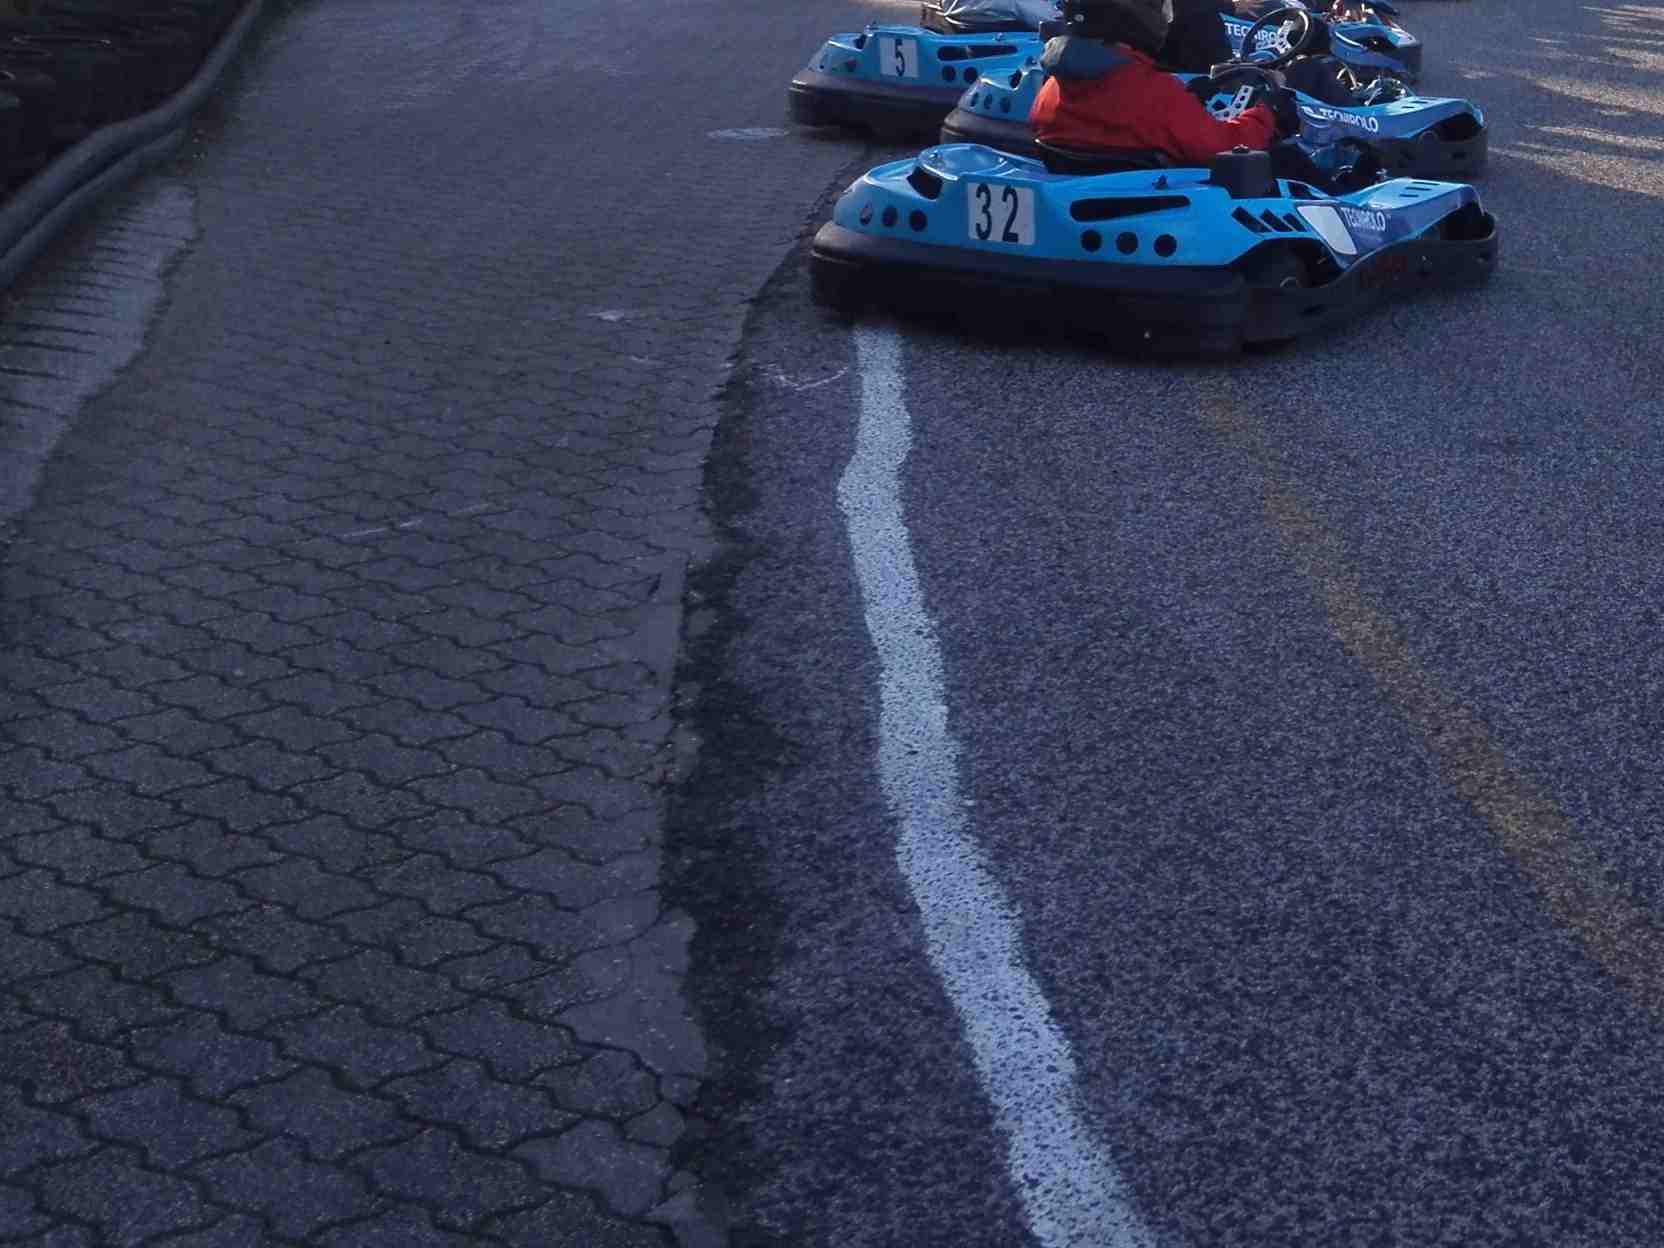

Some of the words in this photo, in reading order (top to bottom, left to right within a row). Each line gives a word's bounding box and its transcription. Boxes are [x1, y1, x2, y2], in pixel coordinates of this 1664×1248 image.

[895, 38, 906, 77] 5
[1318, 107, 1380, 134] TECNIROLO
[975, 183, 1019, 243] 32
